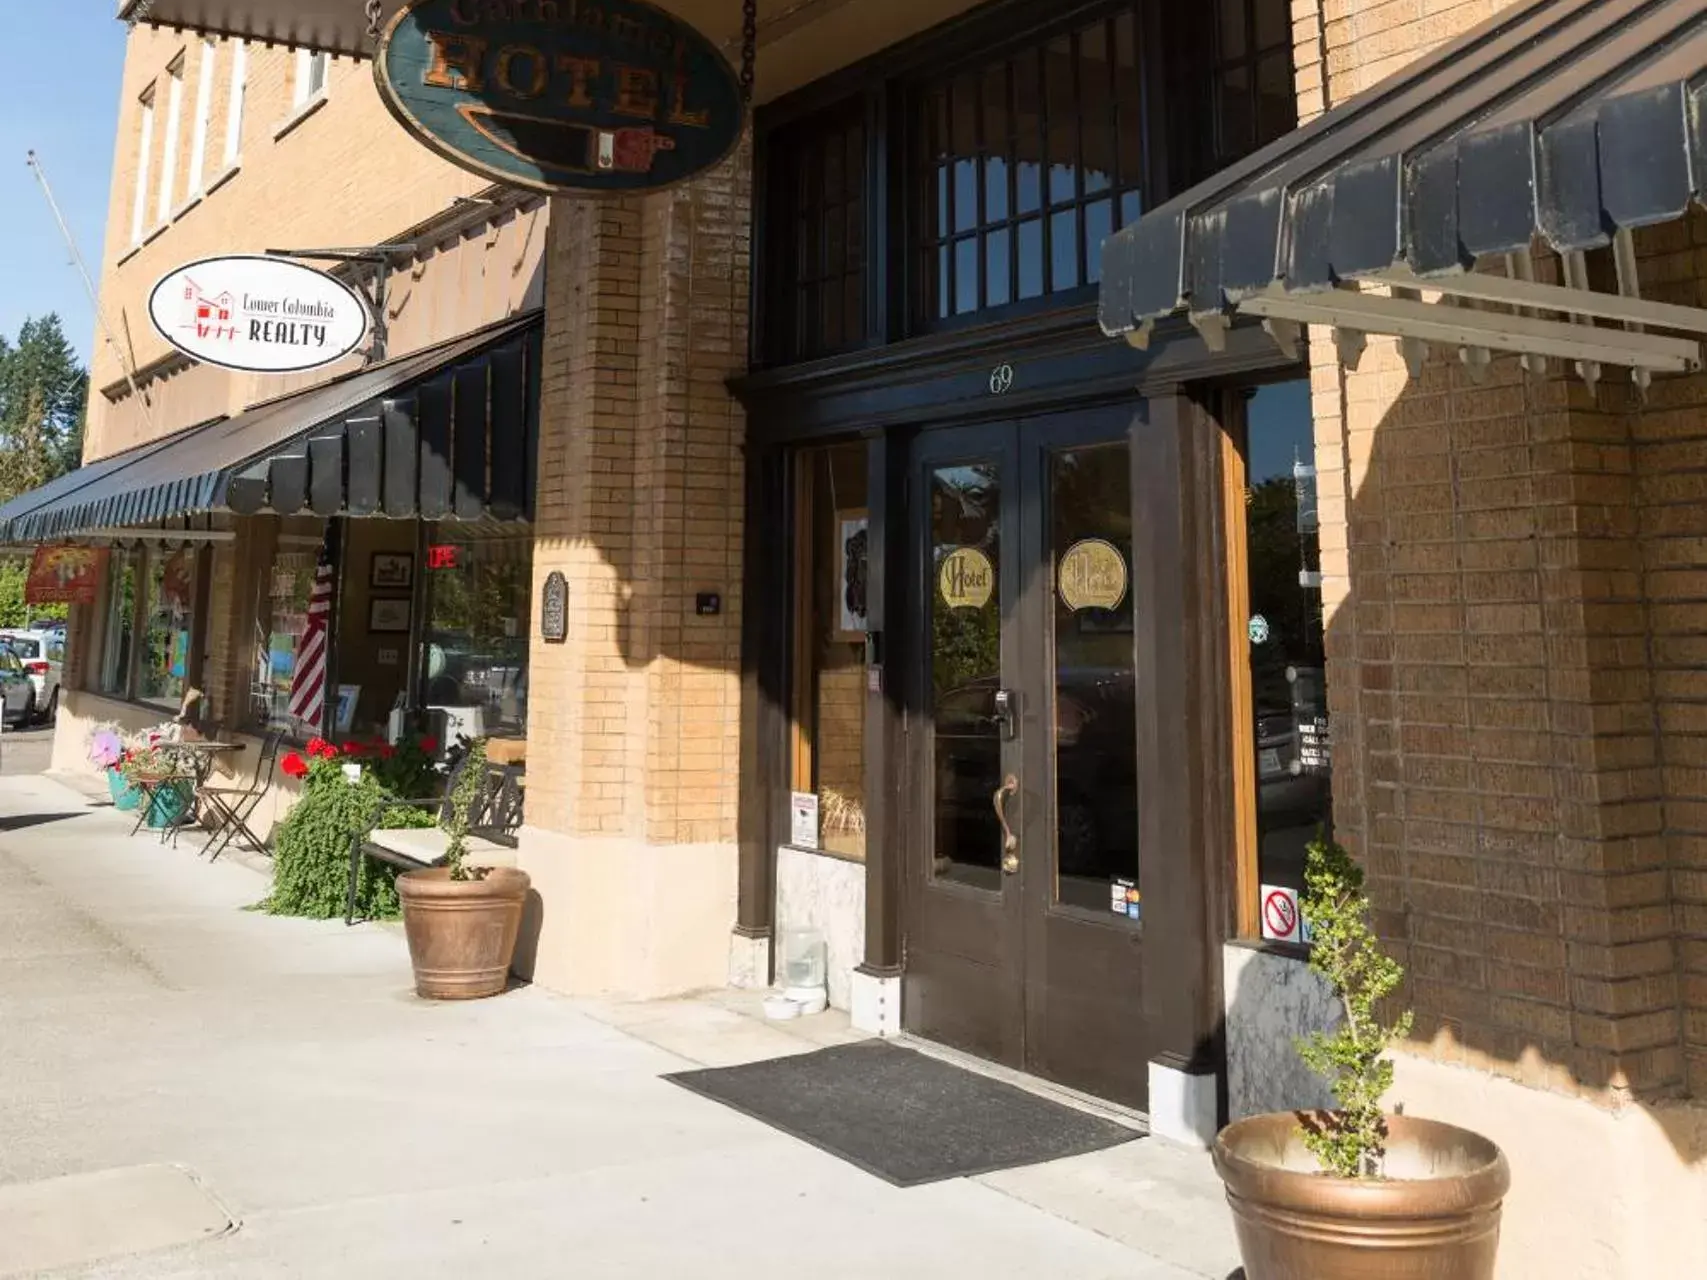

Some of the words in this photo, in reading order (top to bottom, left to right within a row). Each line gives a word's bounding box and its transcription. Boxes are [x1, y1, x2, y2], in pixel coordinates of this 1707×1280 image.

[421, 30, 710, 128] HOTEL
[243, 293, 280, 313] Lower
[282, 297, 335, 318] Columbia
[249, 318, 326, 347] REALTY
[989, 363, 1013, 396] 69
[945, 555, 987, 598] Hotel
